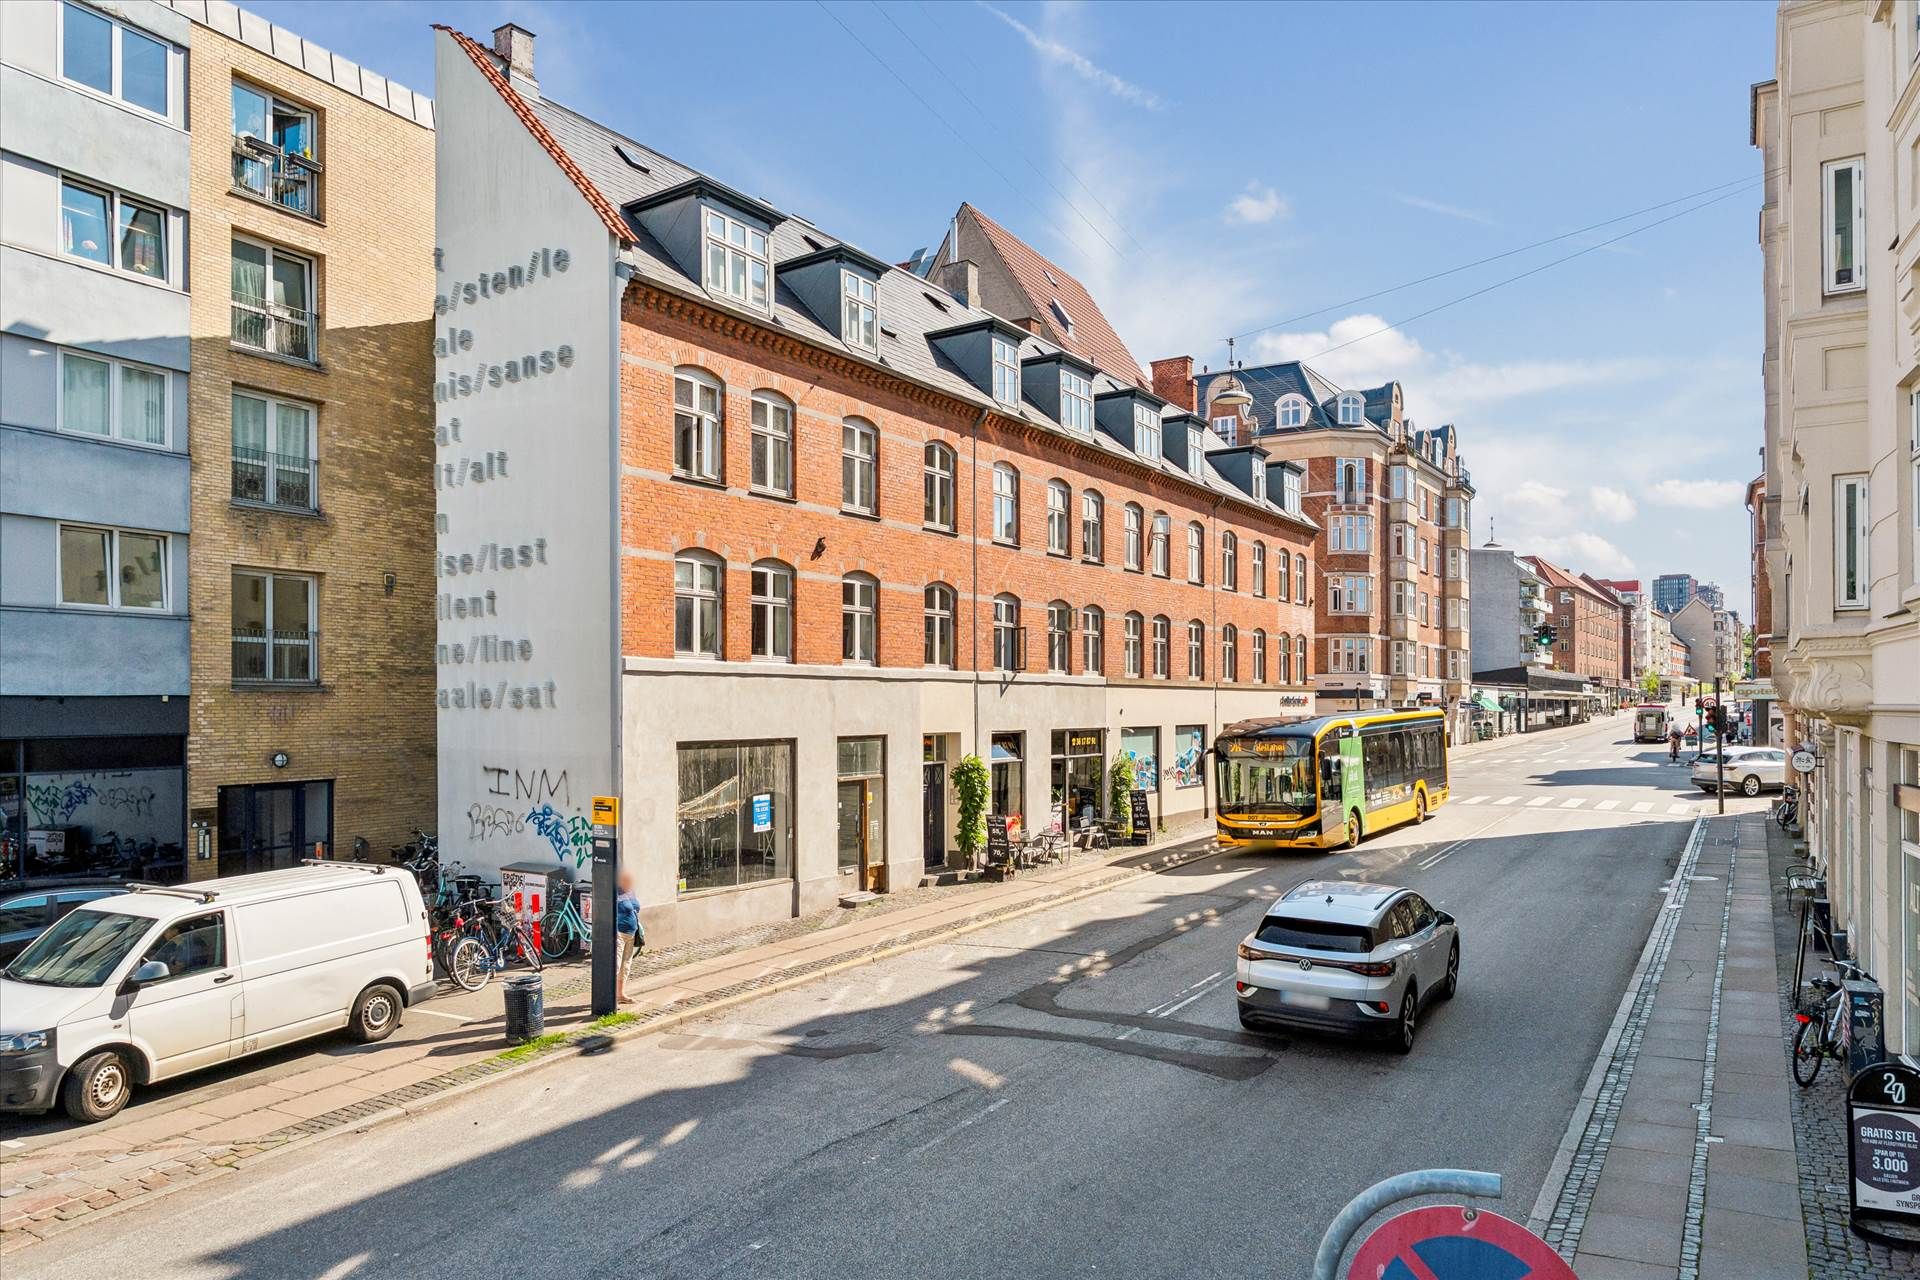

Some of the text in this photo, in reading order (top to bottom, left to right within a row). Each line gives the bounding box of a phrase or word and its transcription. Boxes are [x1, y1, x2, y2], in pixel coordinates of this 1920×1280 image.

[1860, 1126, 1919, 1143] GRATIS STEL
[1872, 1156, 1908, 1173] 3.000
